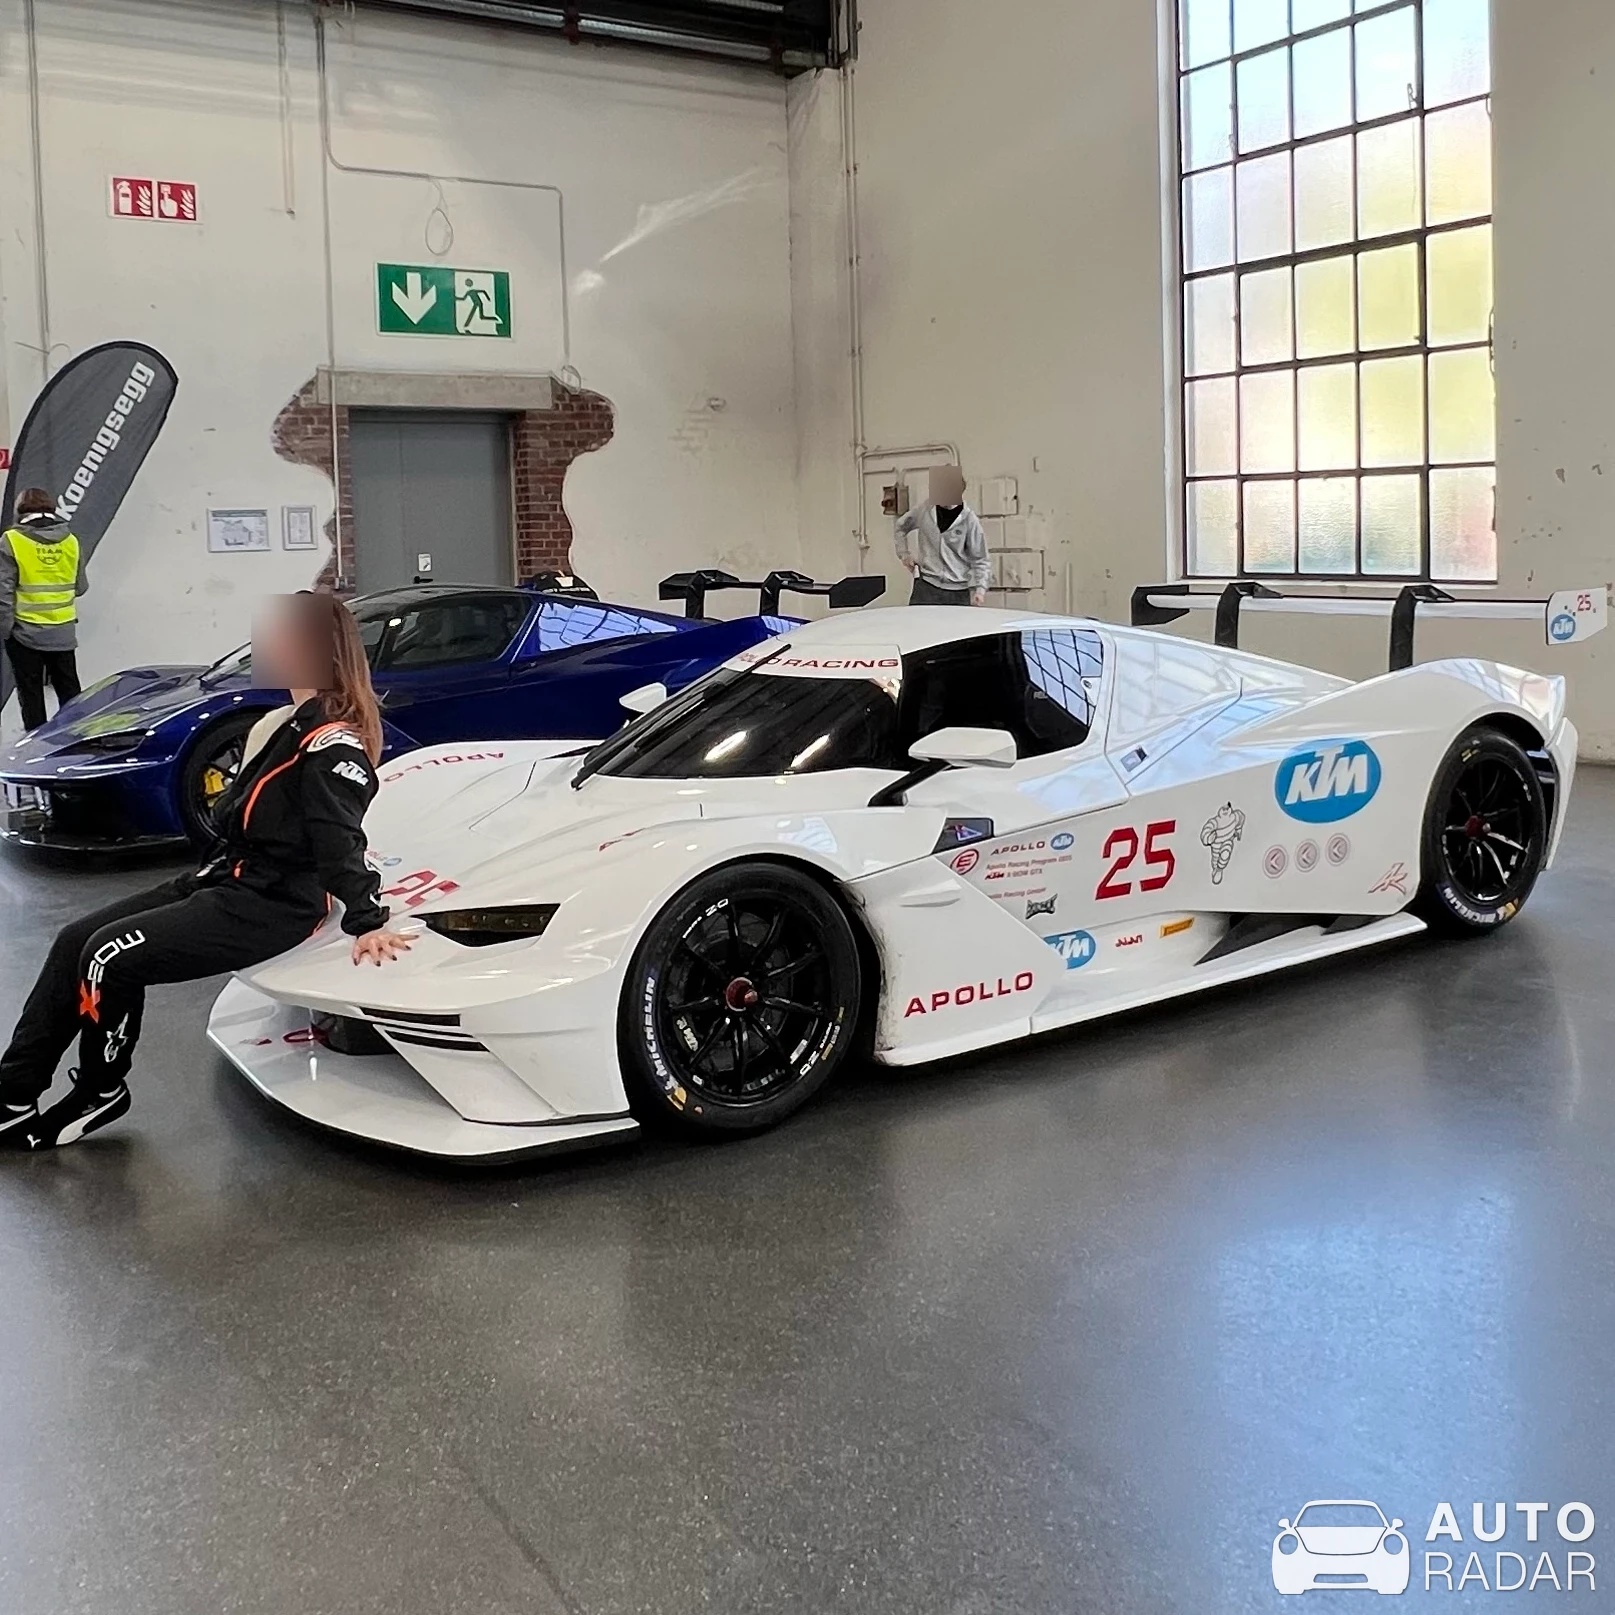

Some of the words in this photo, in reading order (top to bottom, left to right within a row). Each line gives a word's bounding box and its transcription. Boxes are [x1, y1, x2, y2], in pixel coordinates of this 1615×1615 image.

[55, 361, 155, 522] Koenigsegg
[1577, 594, 1592, 612] 25
[331, 760, 370, 787] KTM
[1284, 744, 1368, 805] KTM
[990, 841, 1046, 856] APOLLO
[1095, 819, 1177, 901] 25
[903, 971, 1034, 1019] APOLLO
